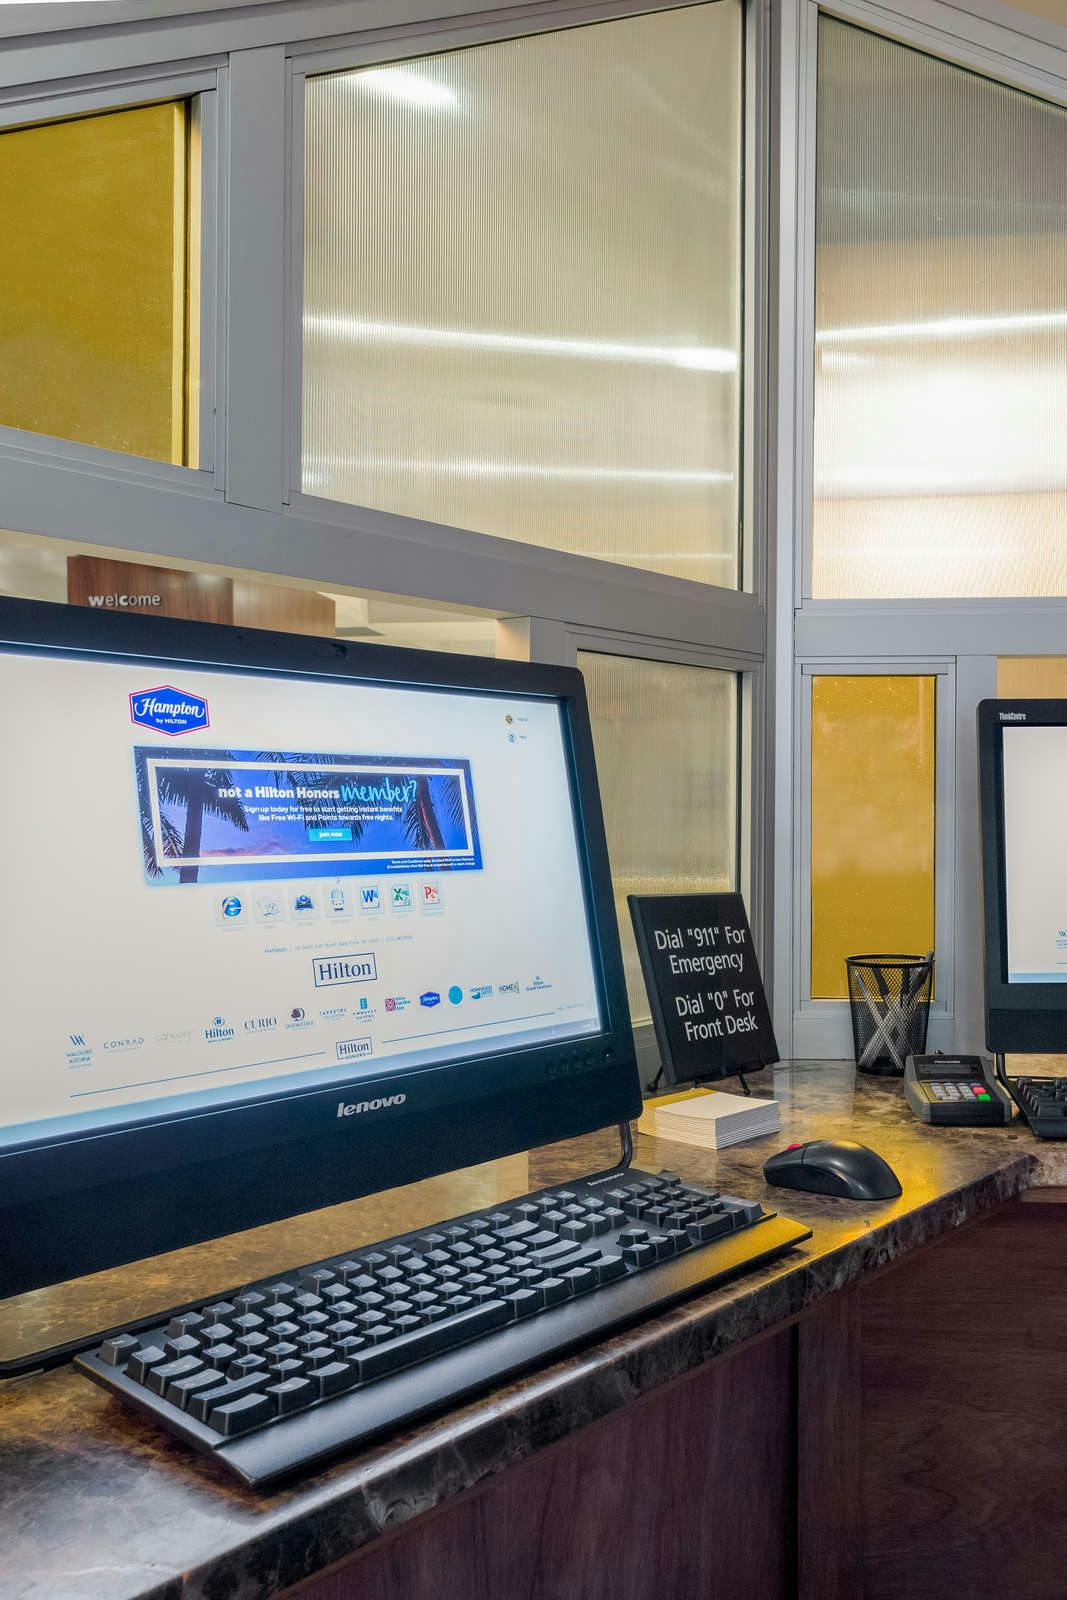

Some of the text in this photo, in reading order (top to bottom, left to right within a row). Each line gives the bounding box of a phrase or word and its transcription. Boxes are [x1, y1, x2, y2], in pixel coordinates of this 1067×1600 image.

[88, 593, 161, 607] welcome
[134, 698, 204, 718] Hampton
[218, 777, 417, 802] not a Hilton Honors member?
[244, 805, 259, 814] Sign
[260, 806, 269, 814] up
[270, 805, 288, 814] today
[336, 806, 358, 814] getting
[374, 814, 394, 822] nights.
[654, 926, 746, 950] Dial "911" For
[319, 962, 372, 981] Hilton
[669, 953, 743, 976] Emergency
[675, 989, 755, 1017] Dial "0" For
[205, 1027, 235, 1039] Hilton
[244, 1017, 278, 1030] CURIO
[684, 1010, 759, 1042] Front Desk
[103, 1036, 145, 1049] CONRAD
[339, 1042, 369, 1055] Hilton
[336, 1092, 407, 1118] lenovo
